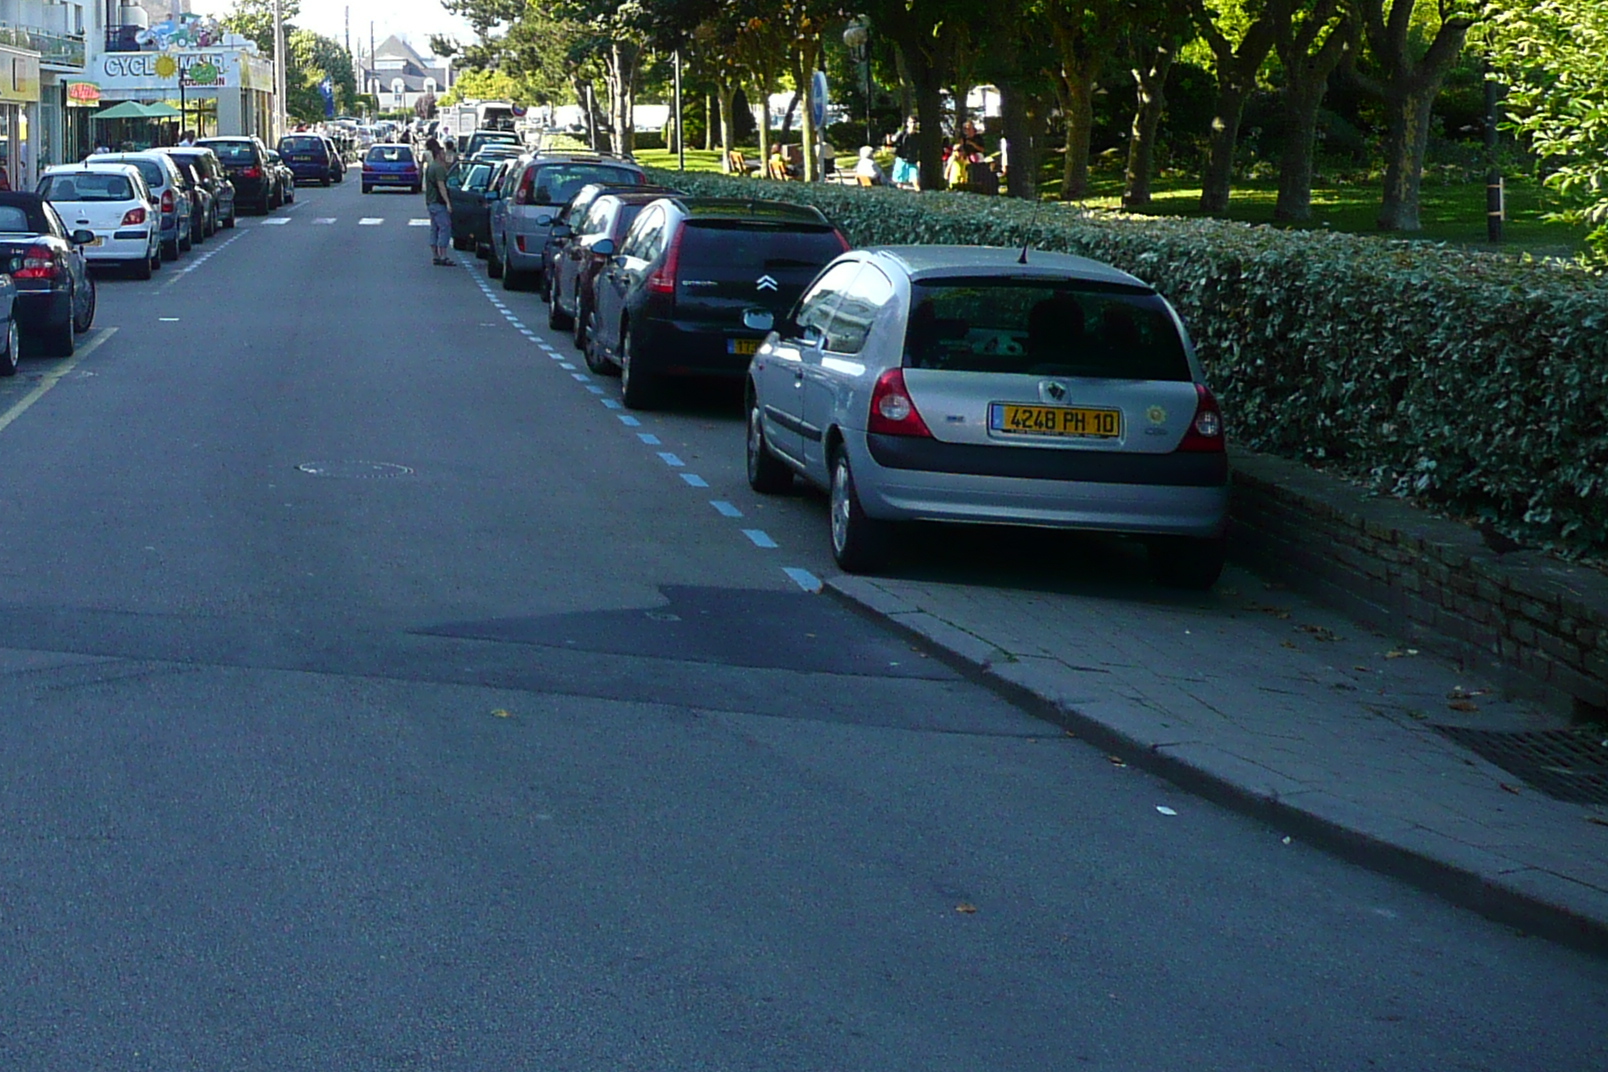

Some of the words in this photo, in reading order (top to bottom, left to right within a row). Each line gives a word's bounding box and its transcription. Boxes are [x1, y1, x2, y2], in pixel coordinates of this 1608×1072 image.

[1010, 408, 1056, 430] 4248
[1063, 411, 1085, 432] PH
[1093, 413, 1114, 434] 10
